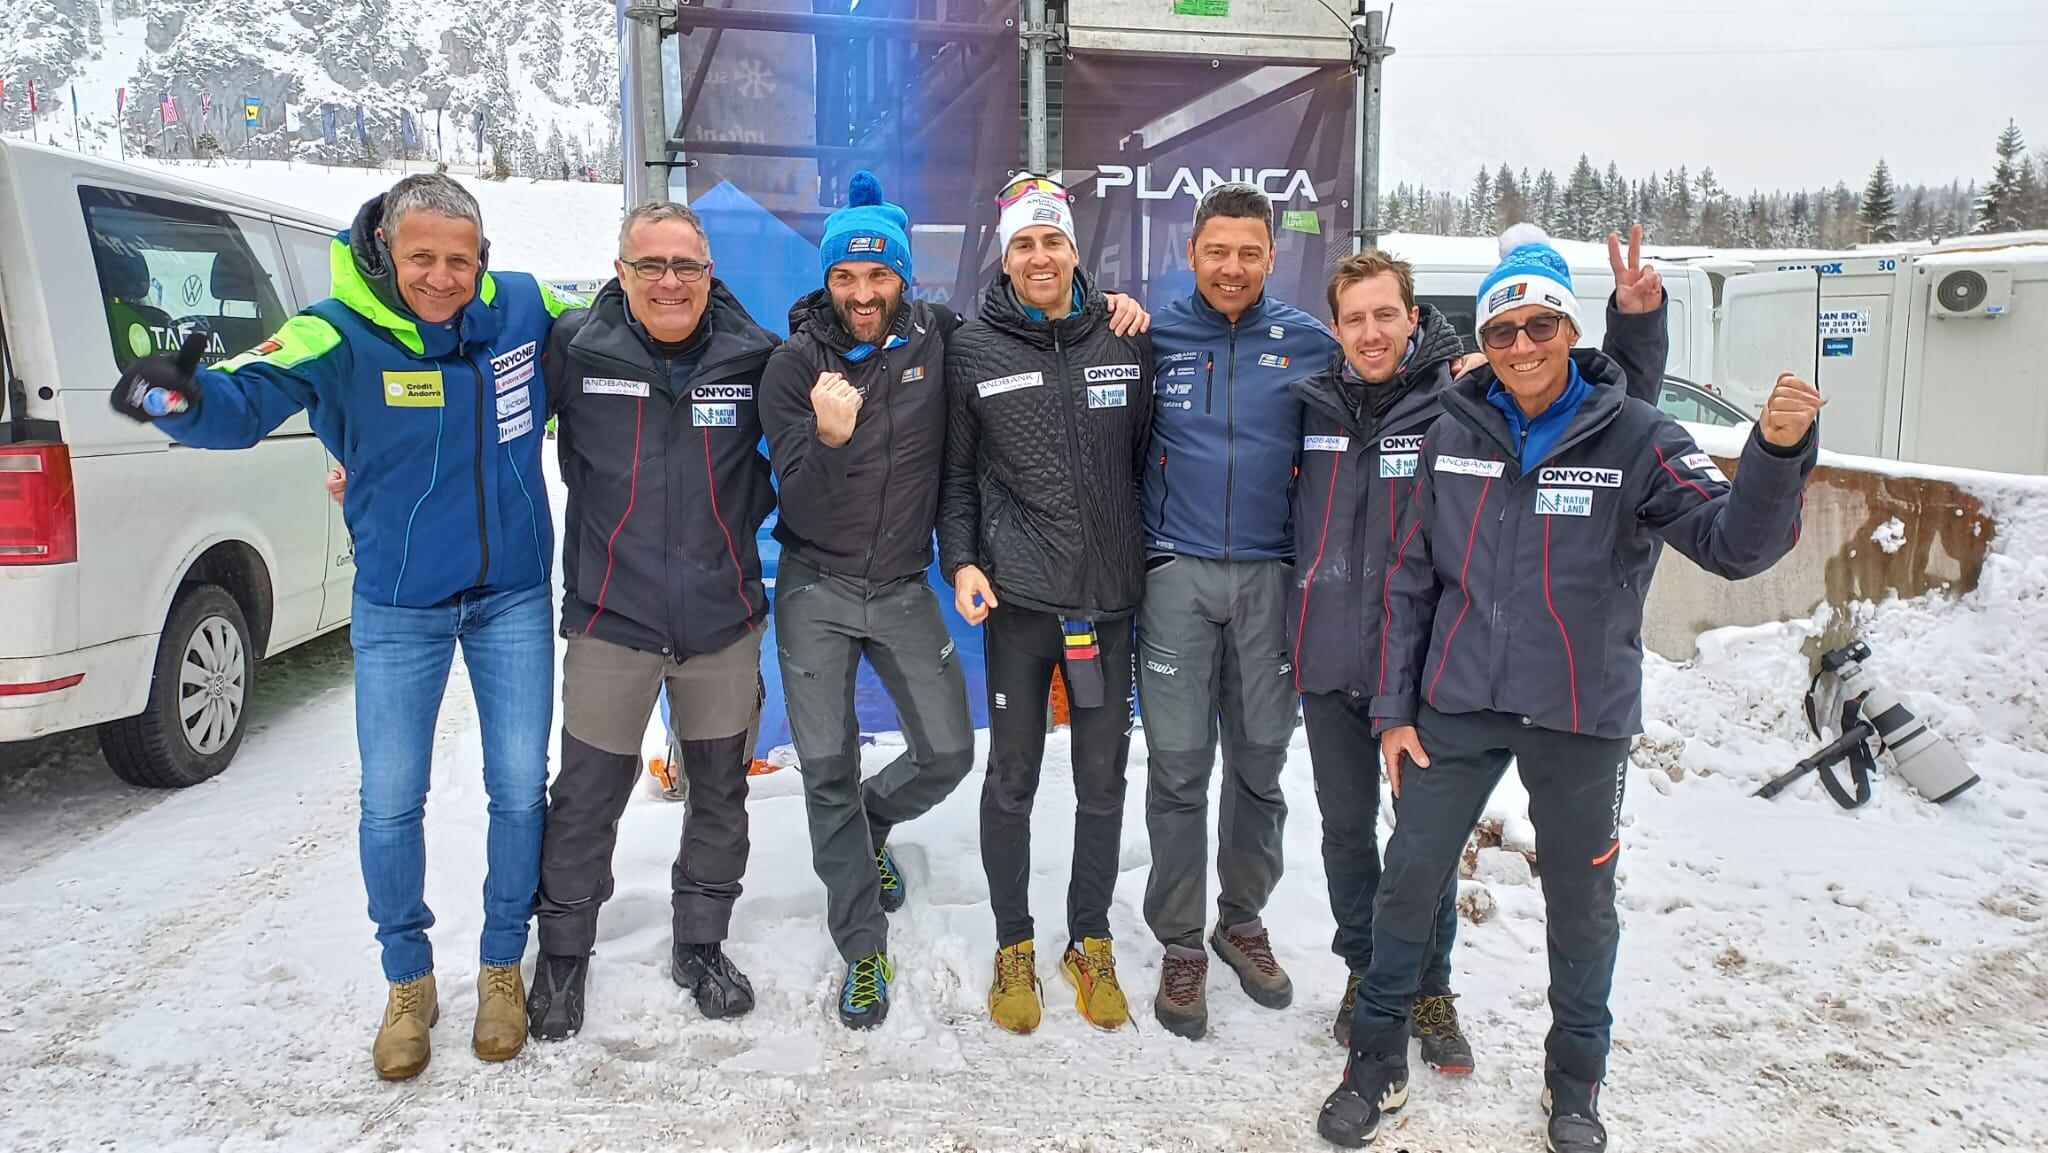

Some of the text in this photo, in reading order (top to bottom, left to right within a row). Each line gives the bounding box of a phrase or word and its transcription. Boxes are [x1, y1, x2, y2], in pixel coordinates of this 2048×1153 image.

[1096, 164, 1319, 203] PLANICA
[1878, 260, 1896, 271] 30
[588, 282, 597, 290] 29
[584, 379, 640, 389] ANDBANK
[980, 374, 1034, 391] ANDBANK
[1107, 388, 1126, 397] NATUR
[1107, 396, 1123, 406] LAND
[715, 408, 735, 417] NATUR
[715, 416, 732, 425] LAND
[1438, 456, 1493, 470] ANDBANK
[1563, 496, 1590, 505] NATUR
[1563, 505, 1585, 513] LAND
[1609, 761, 1624, 840] Andorra
